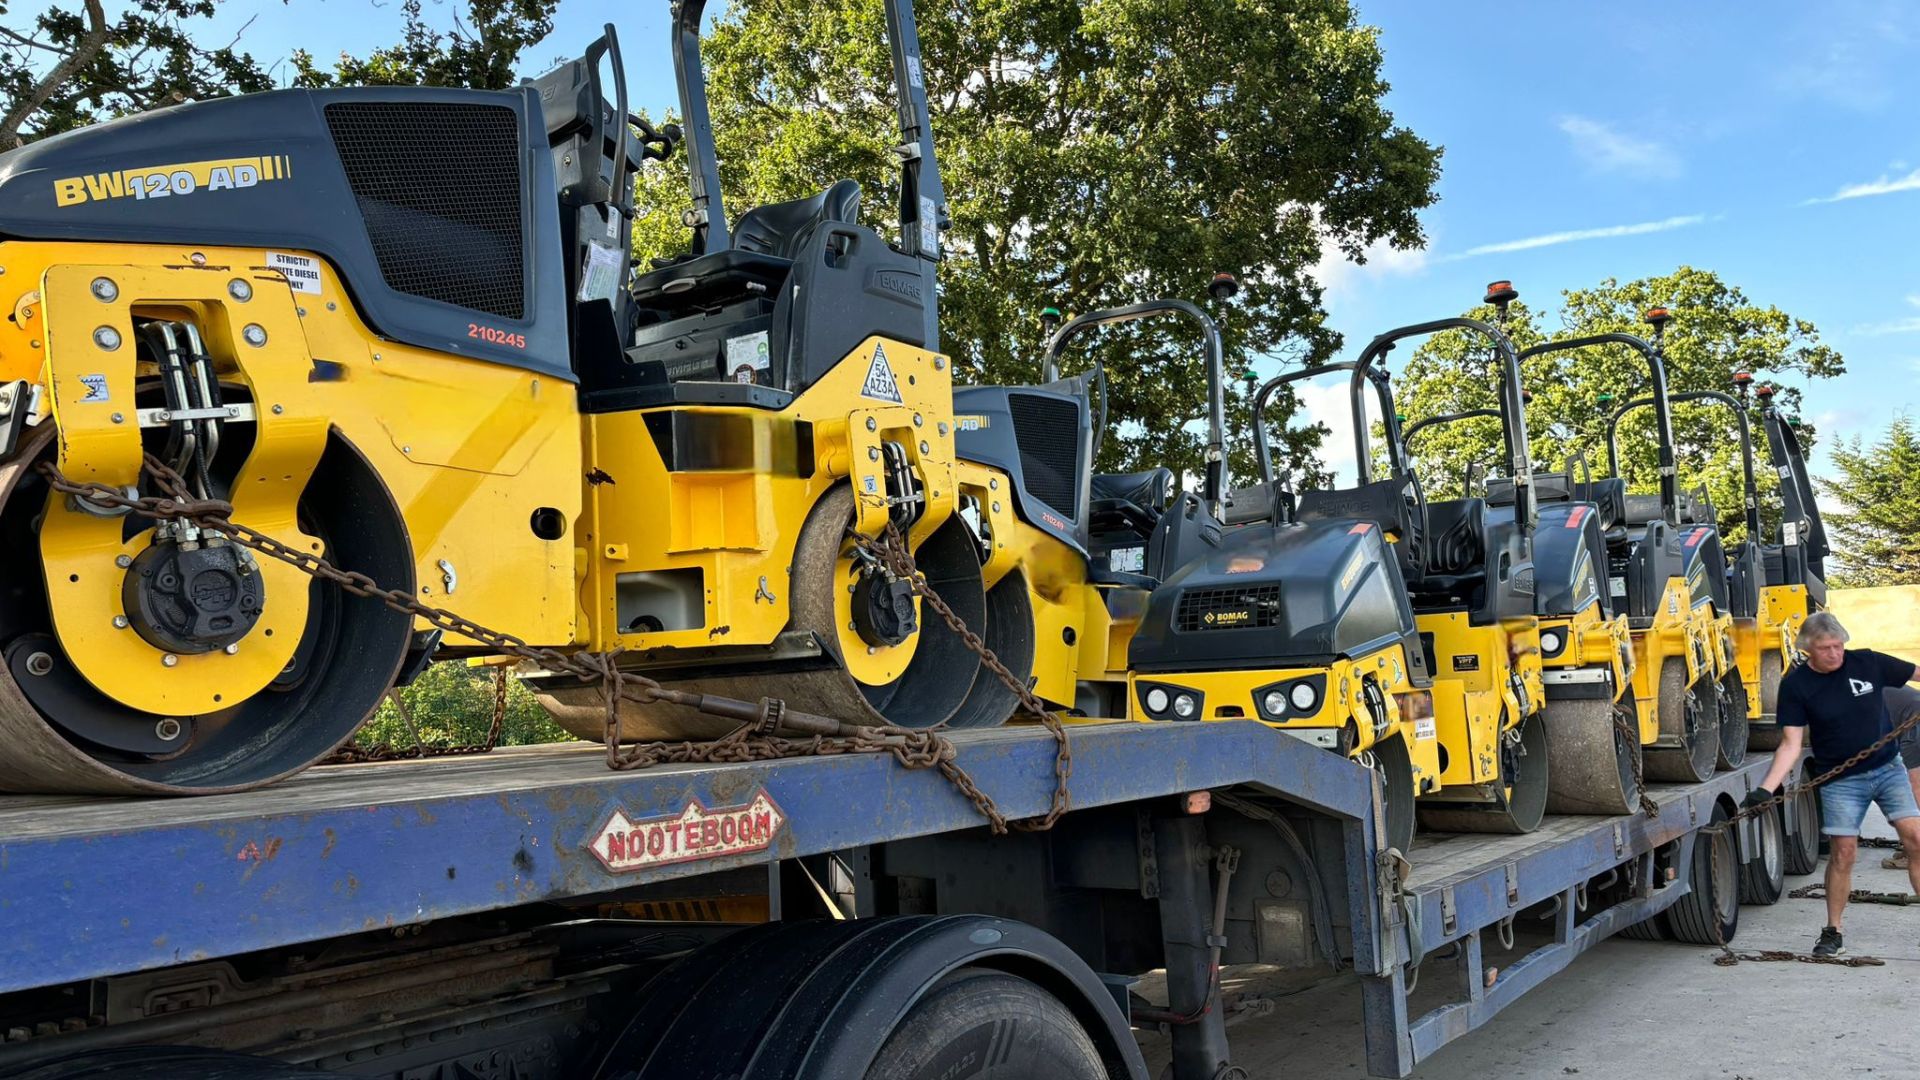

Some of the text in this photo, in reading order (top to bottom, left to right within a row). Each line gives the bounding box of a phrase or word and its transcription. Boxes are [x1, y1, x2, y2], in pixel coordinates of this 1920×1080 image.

[208, 165, 259, 191] AD
[276, 254, 310, 267] STRICTLY
[294, 269, 319, 280] DIESEL
[290, 280, 304, 290] NLY
[468, 323, 526, 348] 210245
[875, 363, 886, 379] 54
[870, 377, 894, 396] AZ3A
[1217, 611, 1249, 621] BOMAG
[607, 810, 772, 862] NOOTEBOOM
